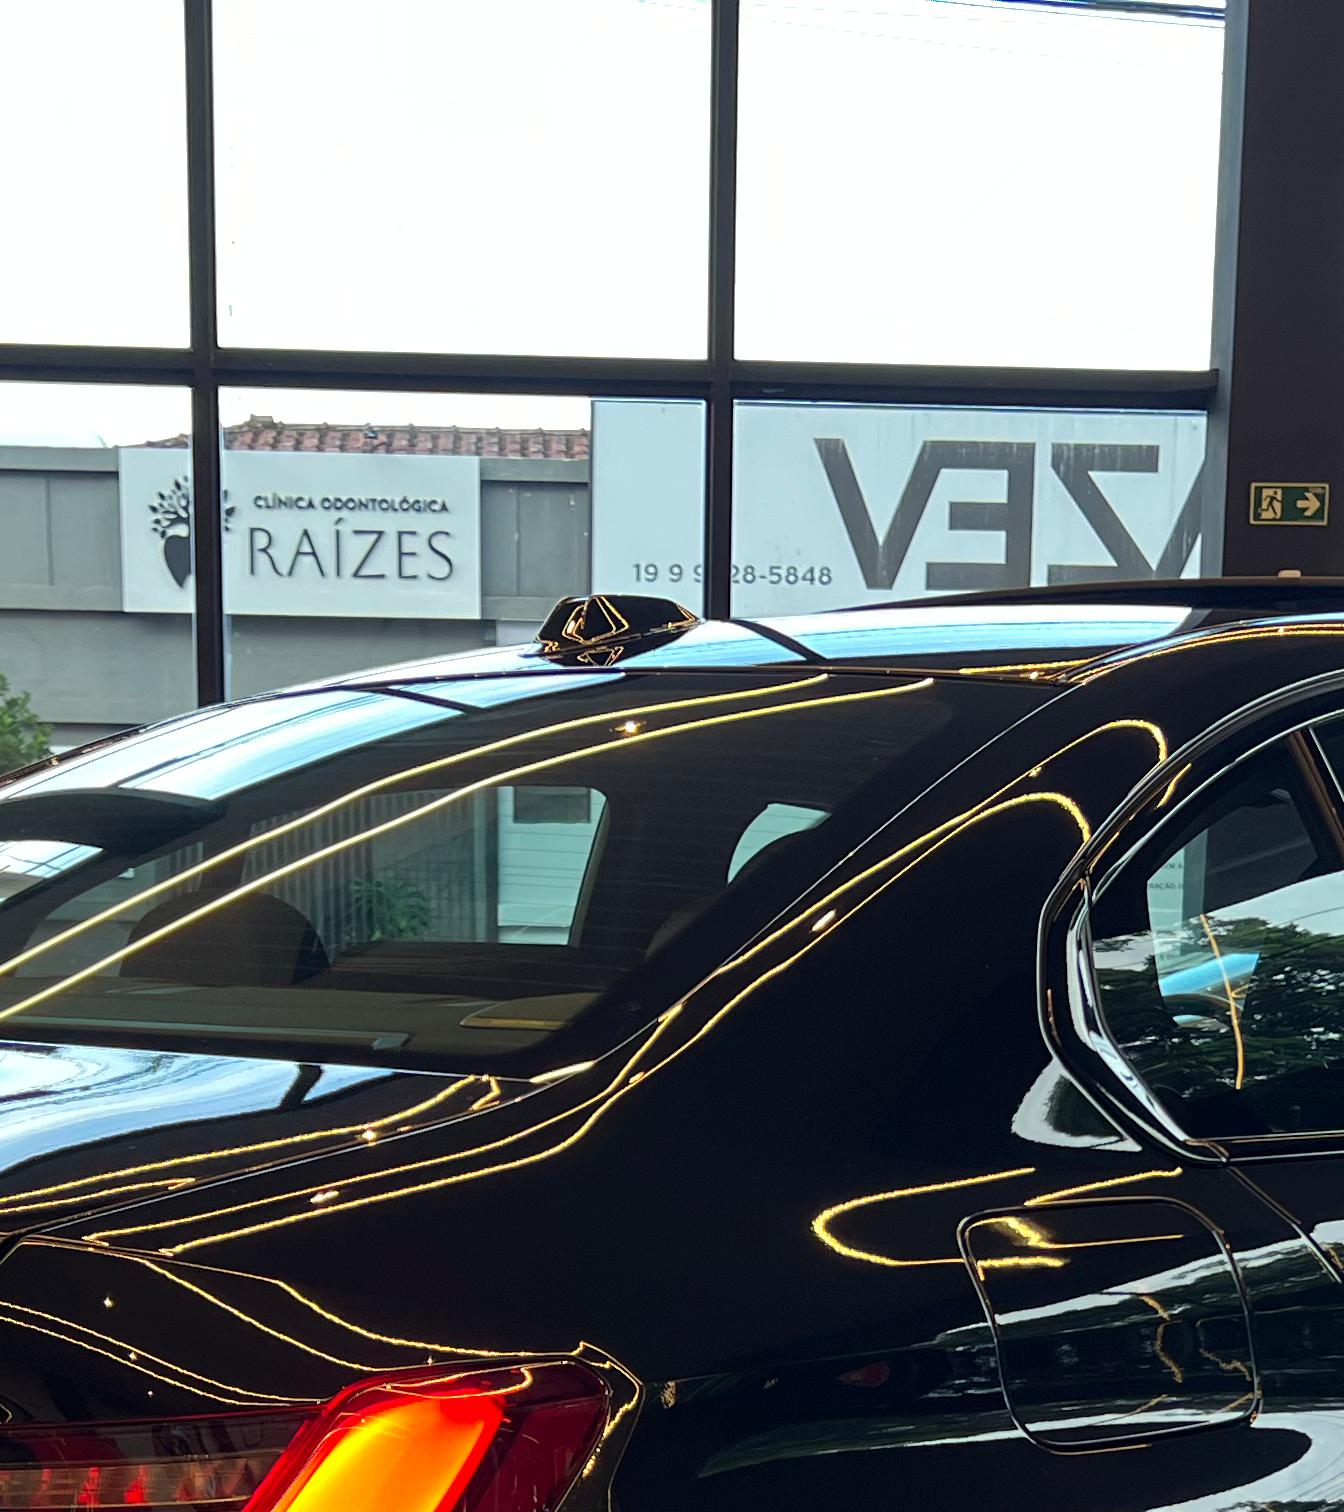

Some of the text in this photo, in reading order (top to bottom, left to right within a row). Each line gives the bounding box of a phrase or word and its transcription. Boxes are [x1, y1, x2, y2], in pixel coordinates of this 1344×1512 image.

[253, 493, 450, 513] CLÍNICA ODONTOLÓGICA
[248, 517, 454, 581] RAÍZES
[693, 563, 833, 586] 928-5848
